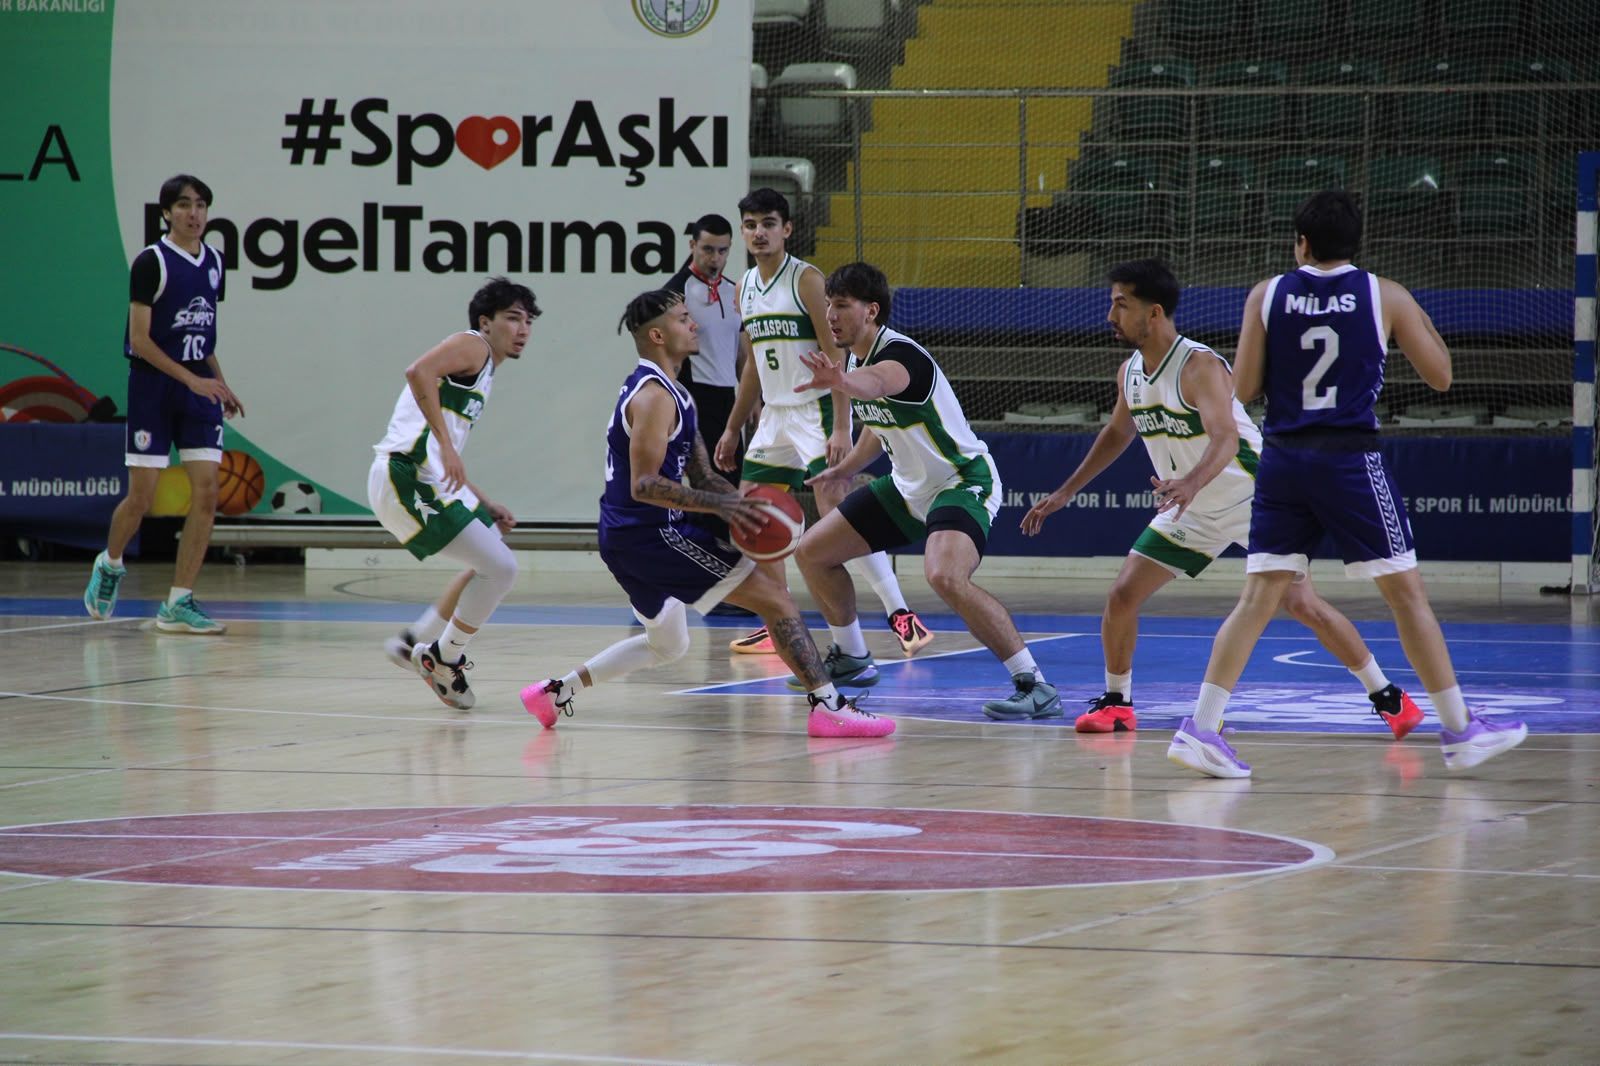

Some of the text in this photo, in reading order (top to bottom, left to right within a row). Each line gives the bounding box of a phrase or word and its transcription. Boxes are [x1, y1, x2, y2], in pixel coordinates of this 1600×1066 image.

[144, 202, 697, 291] ngelTanıma
[1285, 293, 1357, 315] MİLAS
[765, 348, 780, 371] 5
[1300, 325, 1340, 411] 2
[12, 476, 121, 497] MÜDÜRLÜĞÜ
[1105, 489, 1121, 508] İL
[1415, 497, 1462, 513] SPOR
[1468, 494, 1484, 513] İL
[409, 818, 923, 876] GSB
